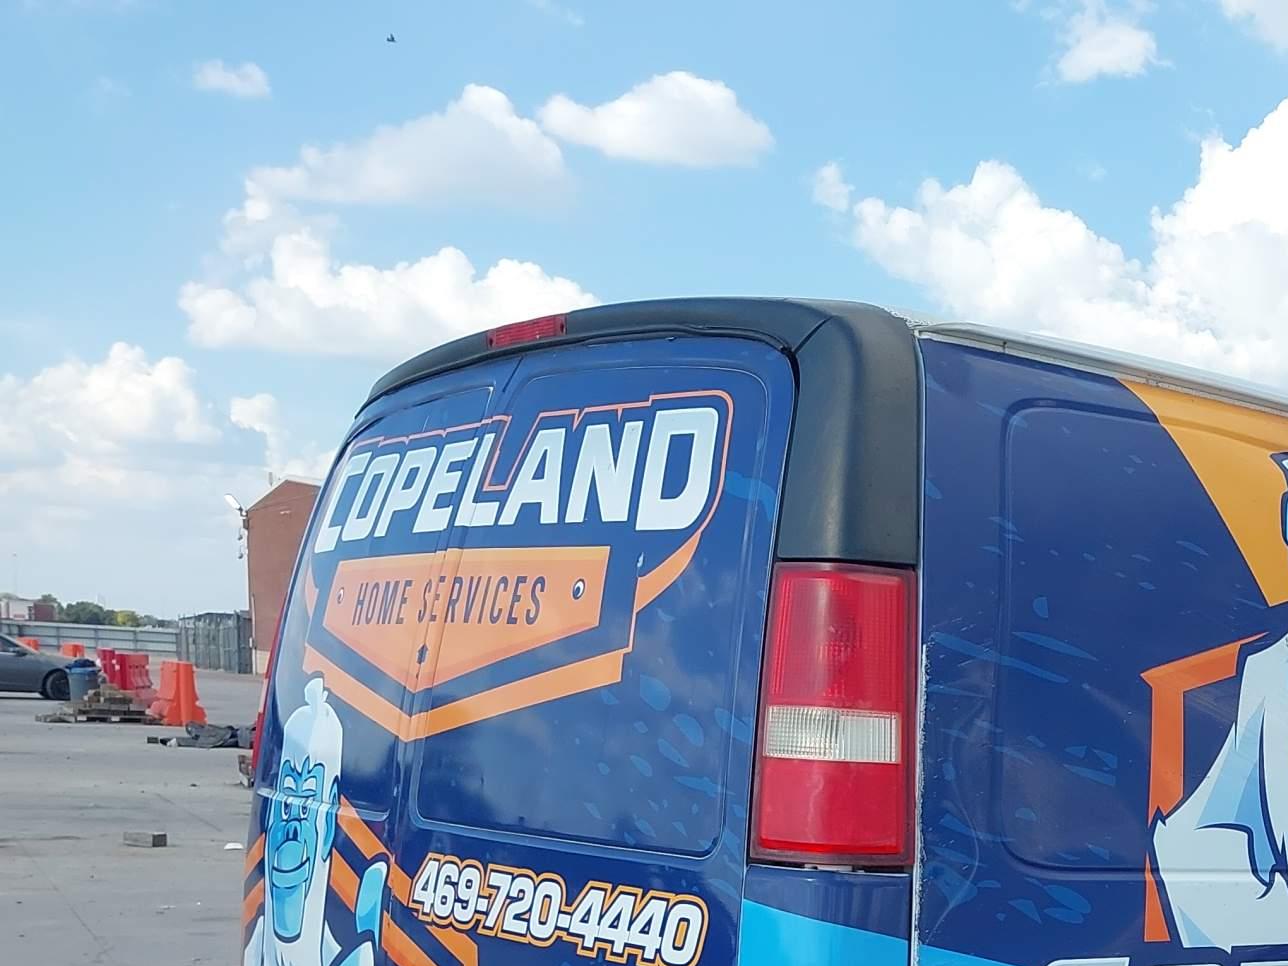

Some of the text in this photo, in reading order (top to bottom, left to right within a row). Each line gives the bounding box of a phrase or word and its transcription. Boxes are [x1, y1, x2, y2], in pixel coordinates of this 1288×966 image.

[314, 407, 719, 553] COPELAND
[352, 576, 547, 625] HOME SERVICES
[413, 860, 700, 966] 469-720-4440
